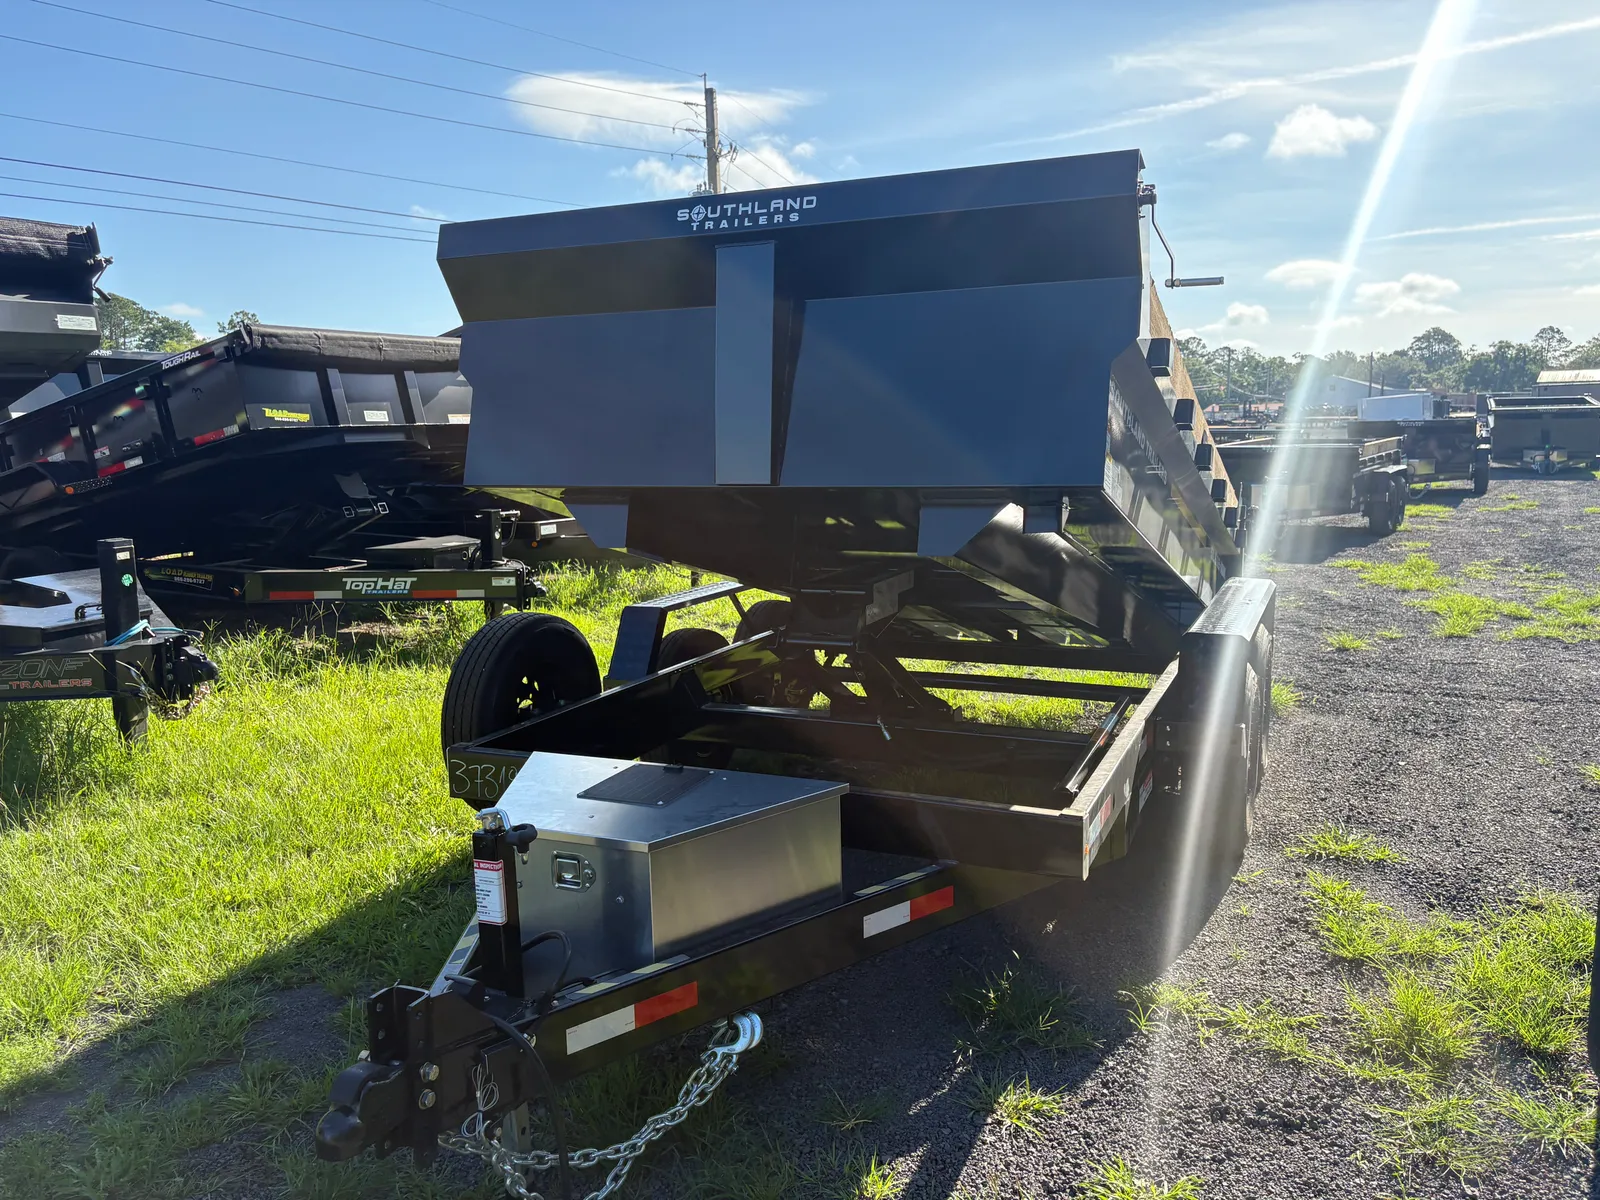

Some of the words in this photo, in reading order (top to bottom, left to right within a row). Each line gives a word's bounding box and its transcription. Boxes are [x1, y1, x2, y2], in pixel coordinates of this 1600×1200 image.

[677, 196, 817, 222] SOUTHLAND
[691, 212, 800, 231] TRAILERS
[161, 567, 183, 577] LOAD
[9, 677, 93, 690] TRAILERS
